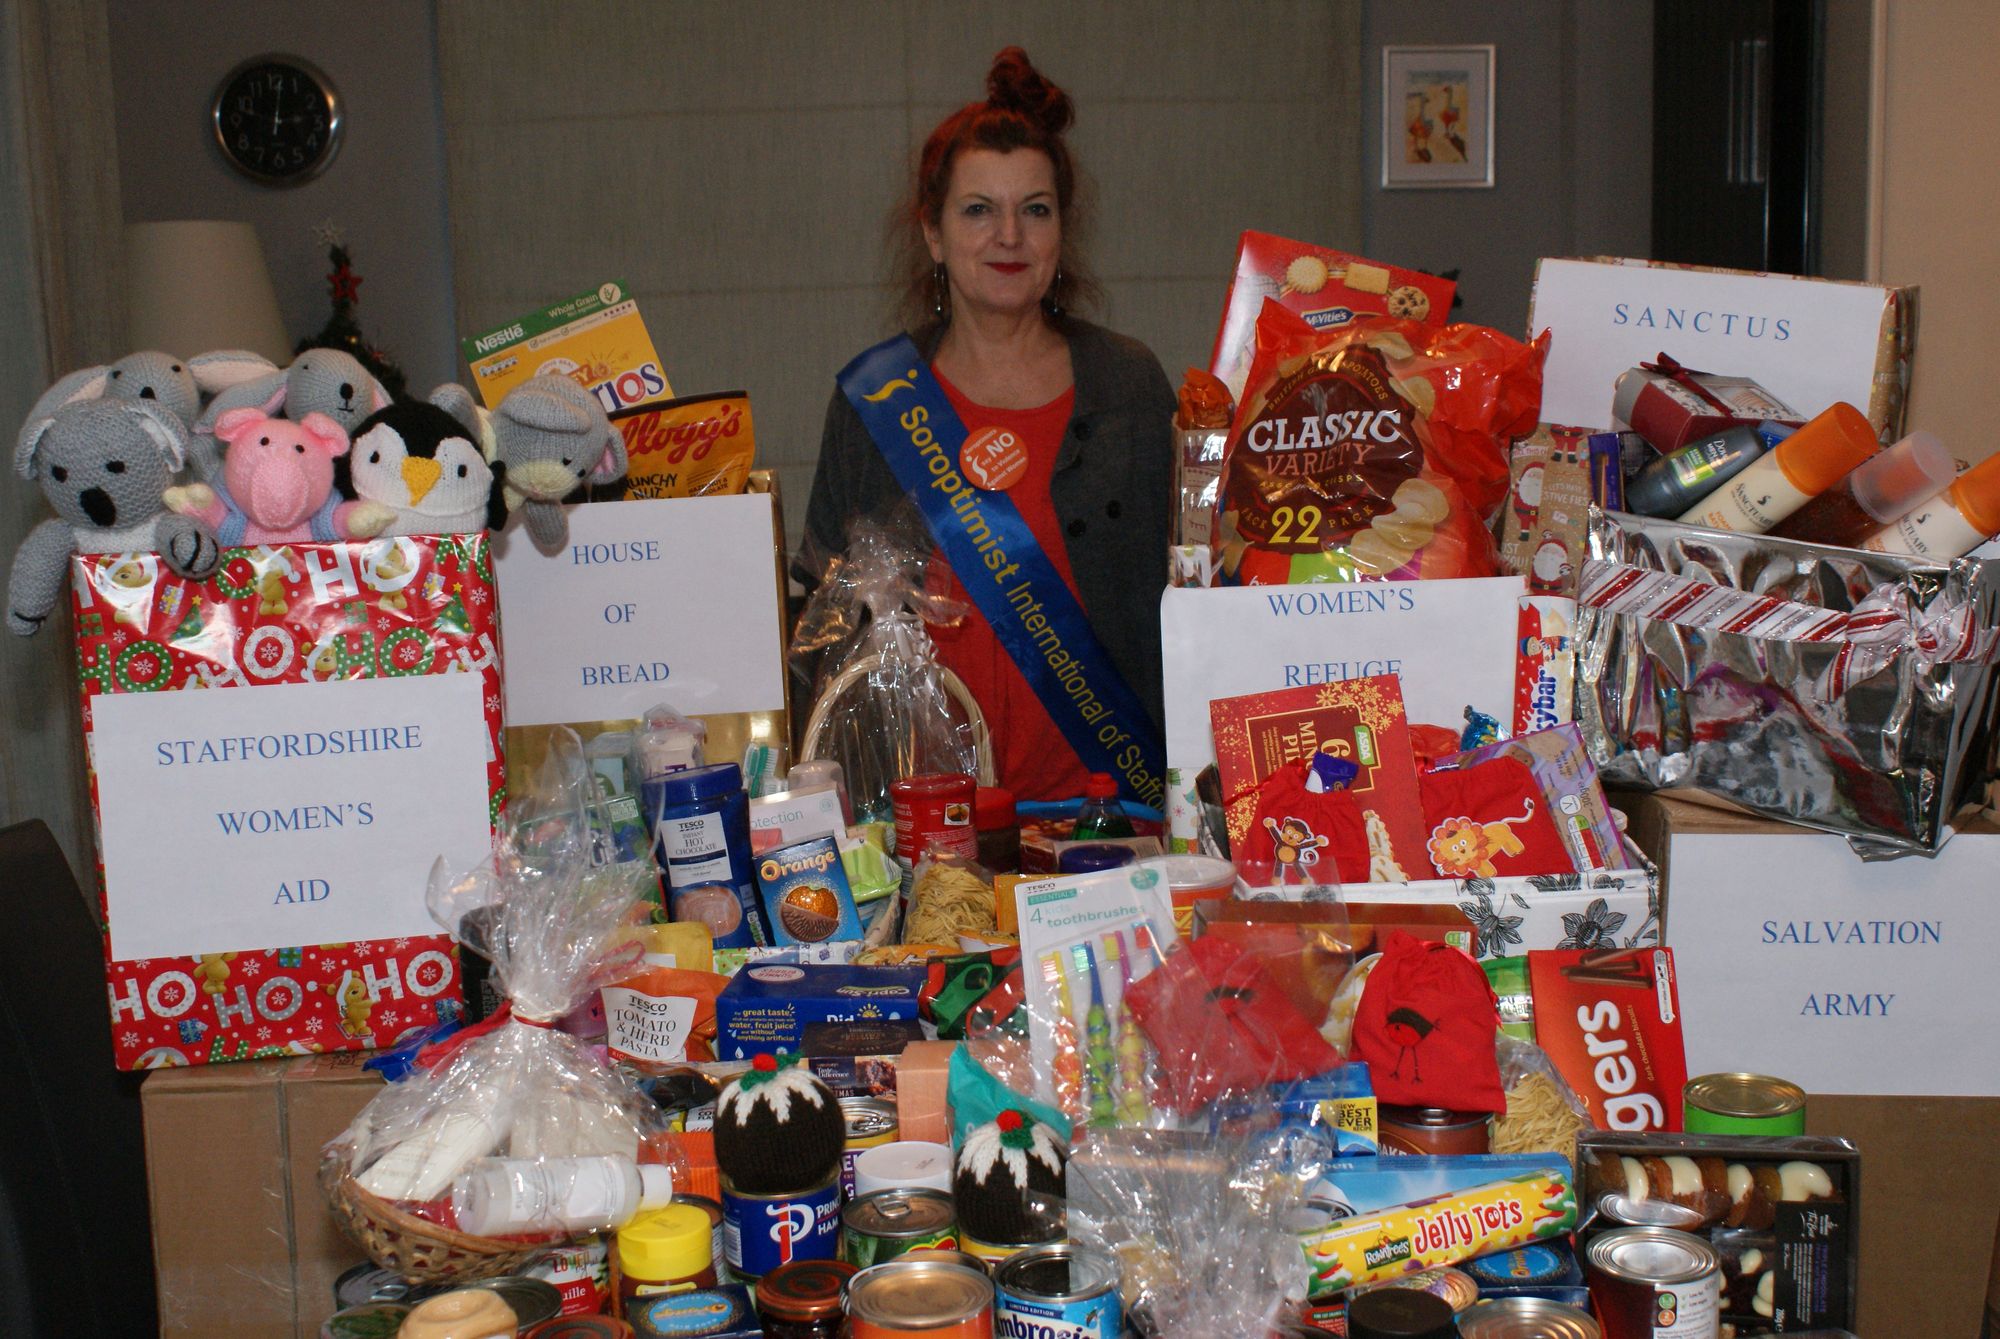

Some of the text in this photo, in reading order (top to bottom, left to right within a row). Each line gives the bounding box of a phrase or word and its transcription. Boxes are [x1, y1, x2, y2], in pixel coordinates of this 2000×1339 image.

[547, 302, 575, 320] Whole
[1613, 303, 1792, 341] SANCTUS
[1248, 409, 1401, 452] CLASSIC
[986, 433, 1015, 458] NO
[1266, 442, 1376, 476] VARIETY
[1268, 505, 1322, 544] 22
[1328, 505, 1375, 529] PACK
[572, 541, 661, 565] HOUSE
[901, 406, 1021, 584] Soroptimist
[1005, 582, 1105, 726] International
[1098, 724, 1130, 750] of
[604, 604, 637, 624] OF
[1266, 588, 1415, 617] WOMEN'S
[582, 662, 670, 686] BREAD
[1283, 659, 1404, 688] REFUGE
[157, 725, 423, 766] STAFFORDSHIRE
[1321, 739, 1351, 758] 6
[1358, 731, 1371, 760] ASDA
[216, 802, 374, 835] WOMEN'S
[678, 819, 705, 829] TESCO
[676, 843, 717, 855] CHOCOLATE
[685, 837, 705, 848] HOT
[760, 851, 836, 882] Orange
[274, 878, 331, 905] AID
[1027, 882, 1056, 892] TESCO
[1030, 907, 1043, 924] 4
[1761, 920, 1943, 945] SALVATION
[629, 995, 668, 1012] TESCO
[742, 1009, 766, 1018] great
[1800, 993, 1896, 1017] ARMY
[614, 1008, 676, 1033] TOMATO
[616, 1022, 670, 1047] & HERB
[766, 1034, 795, 1042] artificial
[621, 1037, 659, 1057] PASTA
[1635, 1031, 1650, 1065] chocolate
[1337, 1117, 1372, 1128] EVER
[1338, 1107, 1372, 1118] BEST
[818, 1218, 839, 1235] HAM
[1415, 1208, 1473, 1254] Jelly
[1472, 1199, 1523, 1237] Tots
[1029, 1307, 1055, 1317] EDITION
